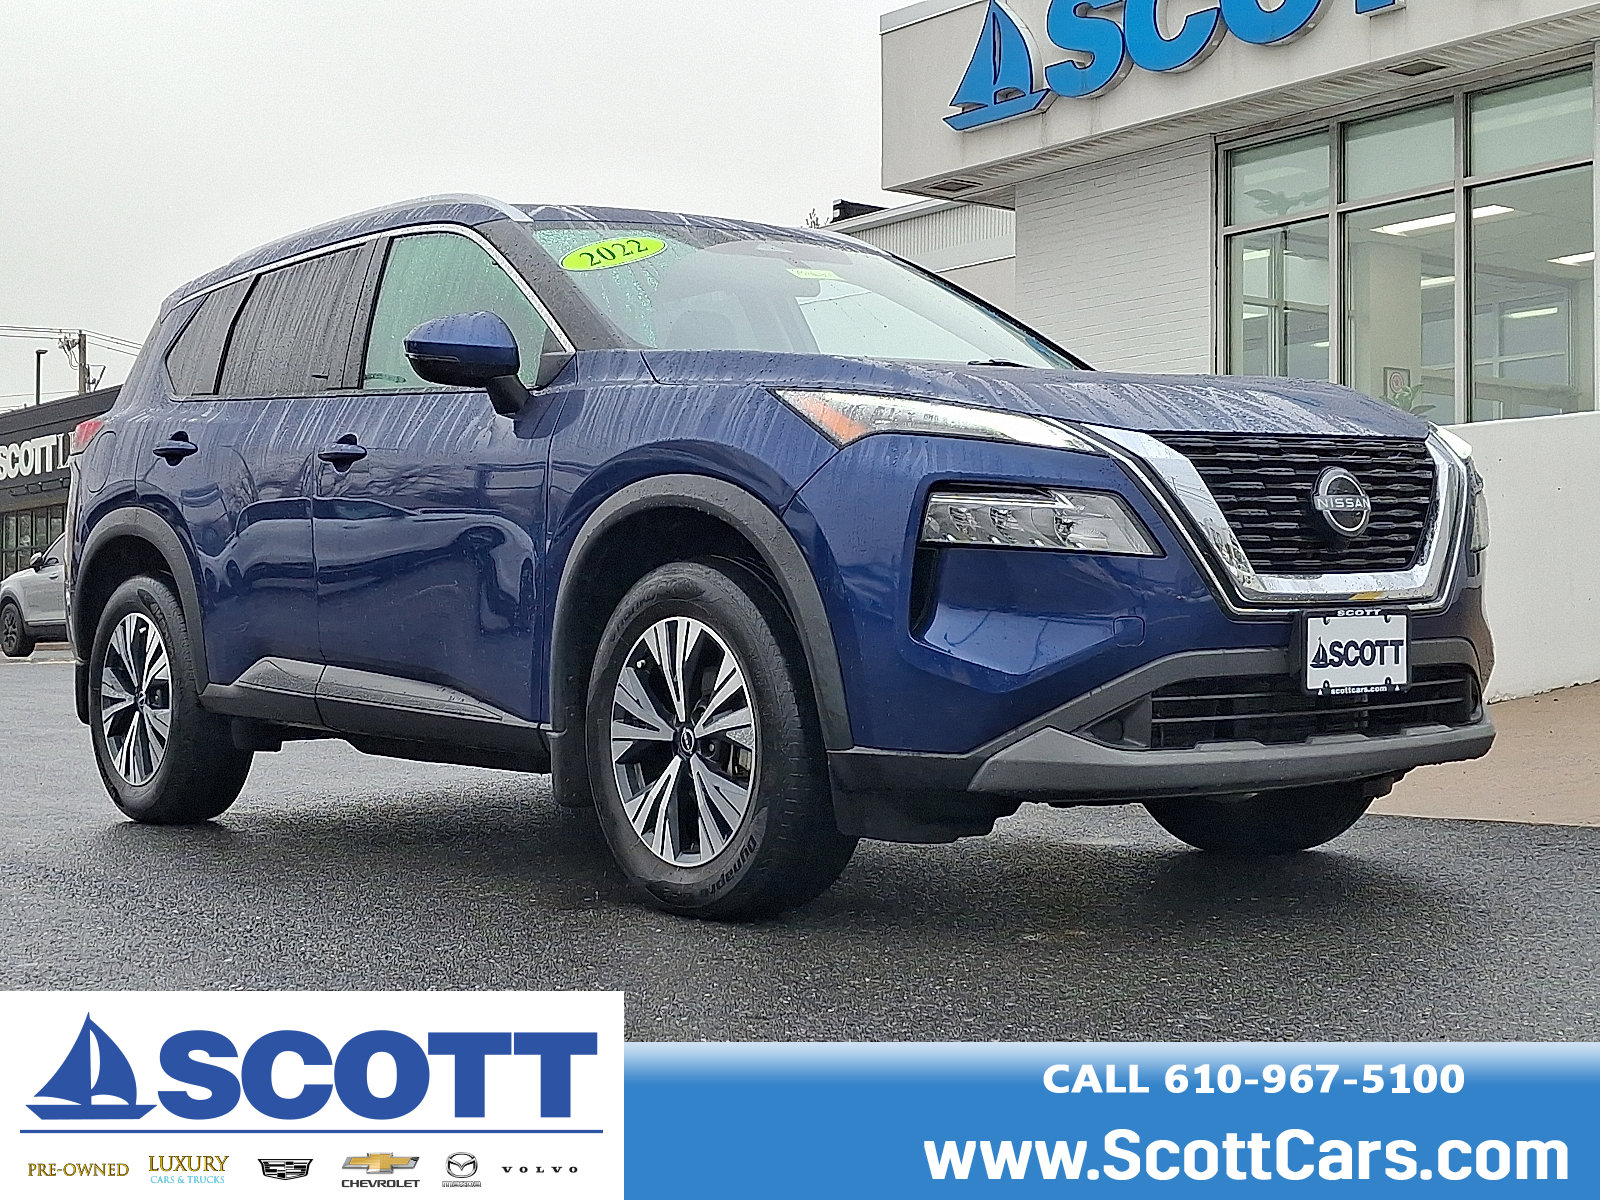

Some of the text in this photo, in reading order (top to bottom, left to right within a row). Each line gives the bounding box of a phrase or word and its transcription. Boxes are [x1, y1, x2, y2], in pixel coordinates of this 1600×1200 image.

[579, 239, 649, 267] 2022
[1317, 497, 1370, 509] NISSAN
[1337, 609, 1381, 617] SCOTT
[1328, 639, 1404, 668] SCOTT
[1330, 684, 1388, 695] scottcars.com
